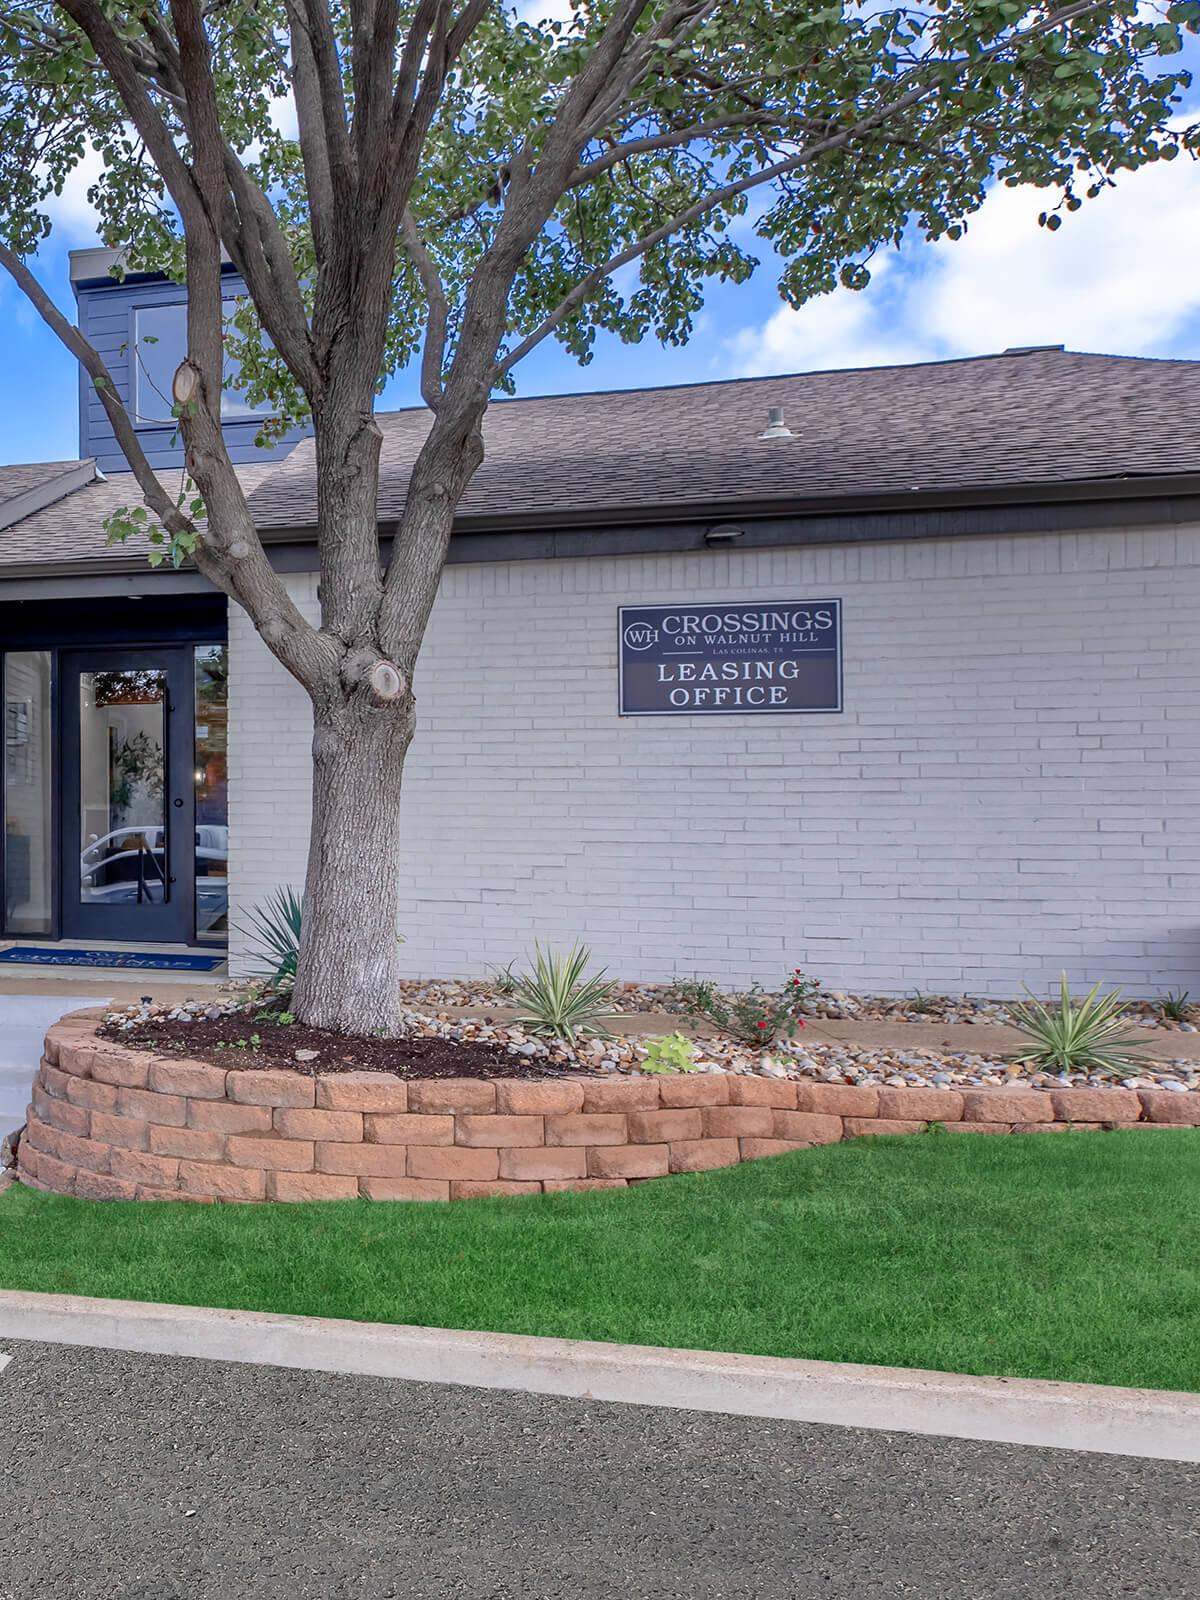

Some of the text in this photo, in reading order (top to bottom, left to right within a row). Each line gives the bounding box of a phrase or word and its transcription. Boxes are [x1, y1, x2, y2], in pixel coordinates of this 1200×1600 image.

[662, 610, 833, 634] CROSSINGS
[674, 631, 819, 646] ON WALNUT HILL
[657, 660, 800, 682] LEASING
[669, 686, 789, 706] OFFICE
